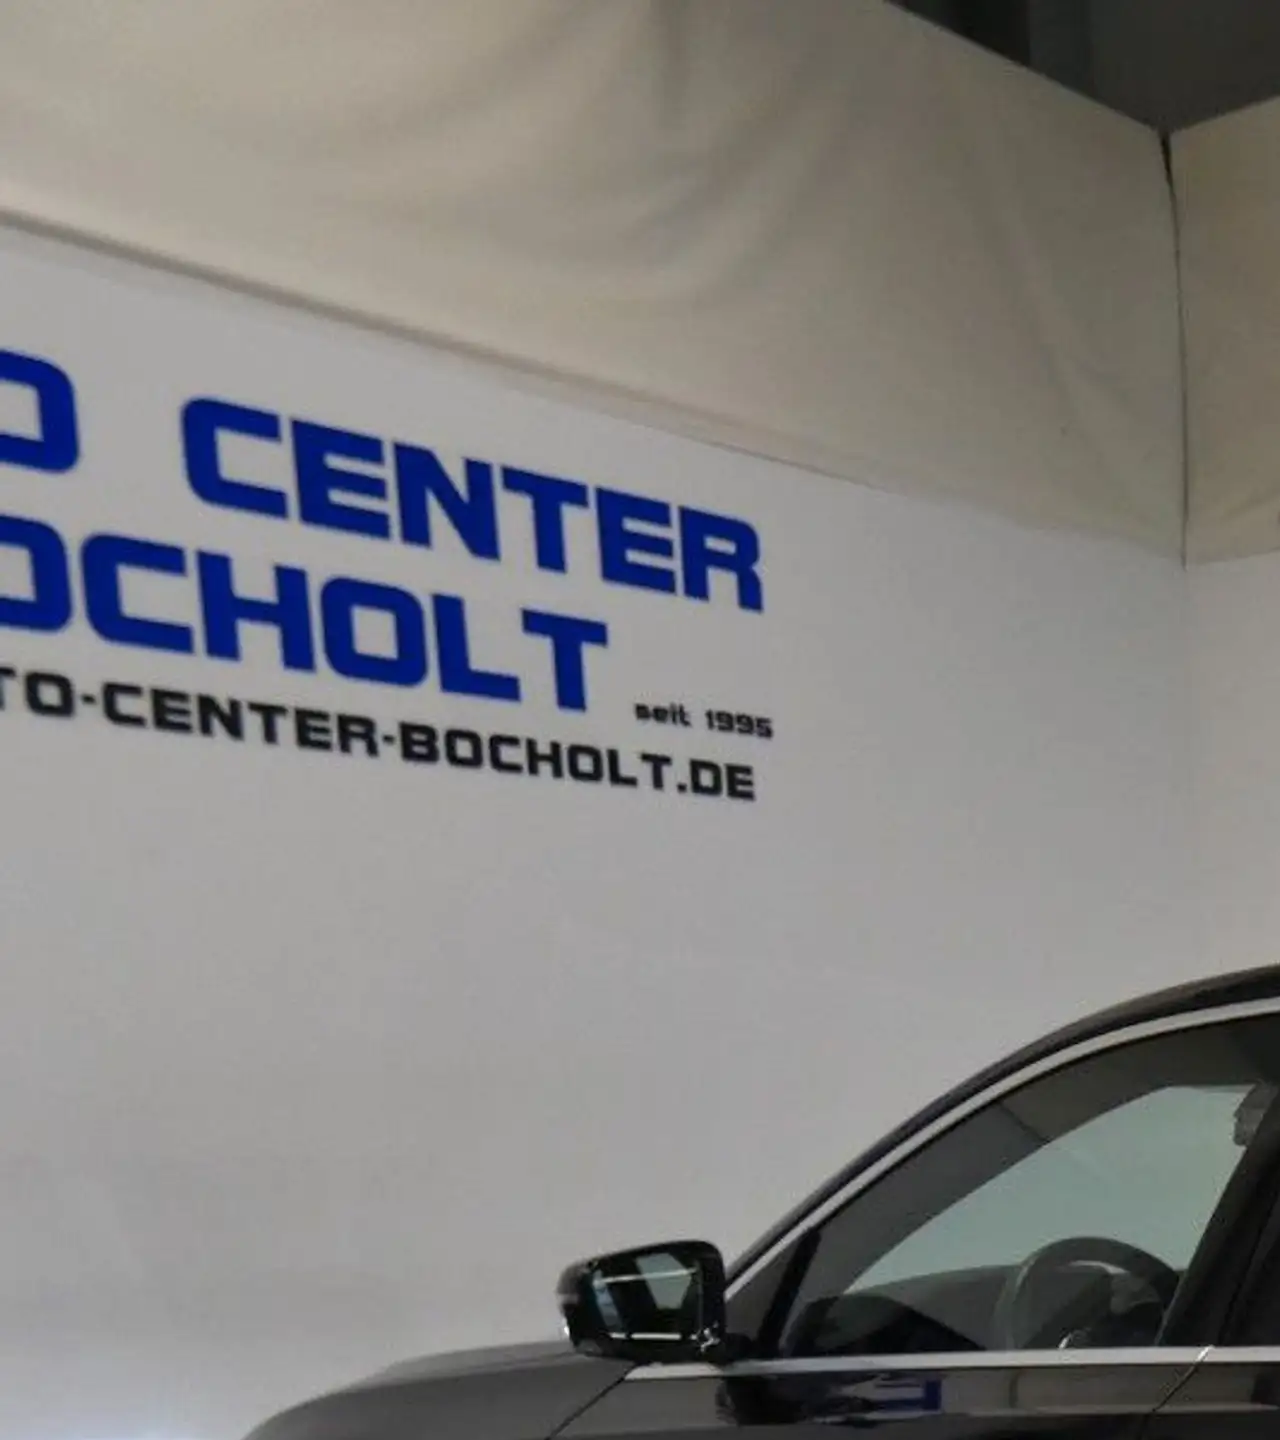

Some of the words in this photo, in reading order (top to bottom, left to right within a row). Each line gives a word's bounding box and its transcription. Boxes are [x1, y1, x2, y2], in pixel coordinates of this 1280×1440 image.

[181, 396, 765, 613] CENTER
[634, 702, 692, 728] seit
[705, 708, 774, 740] 1995
